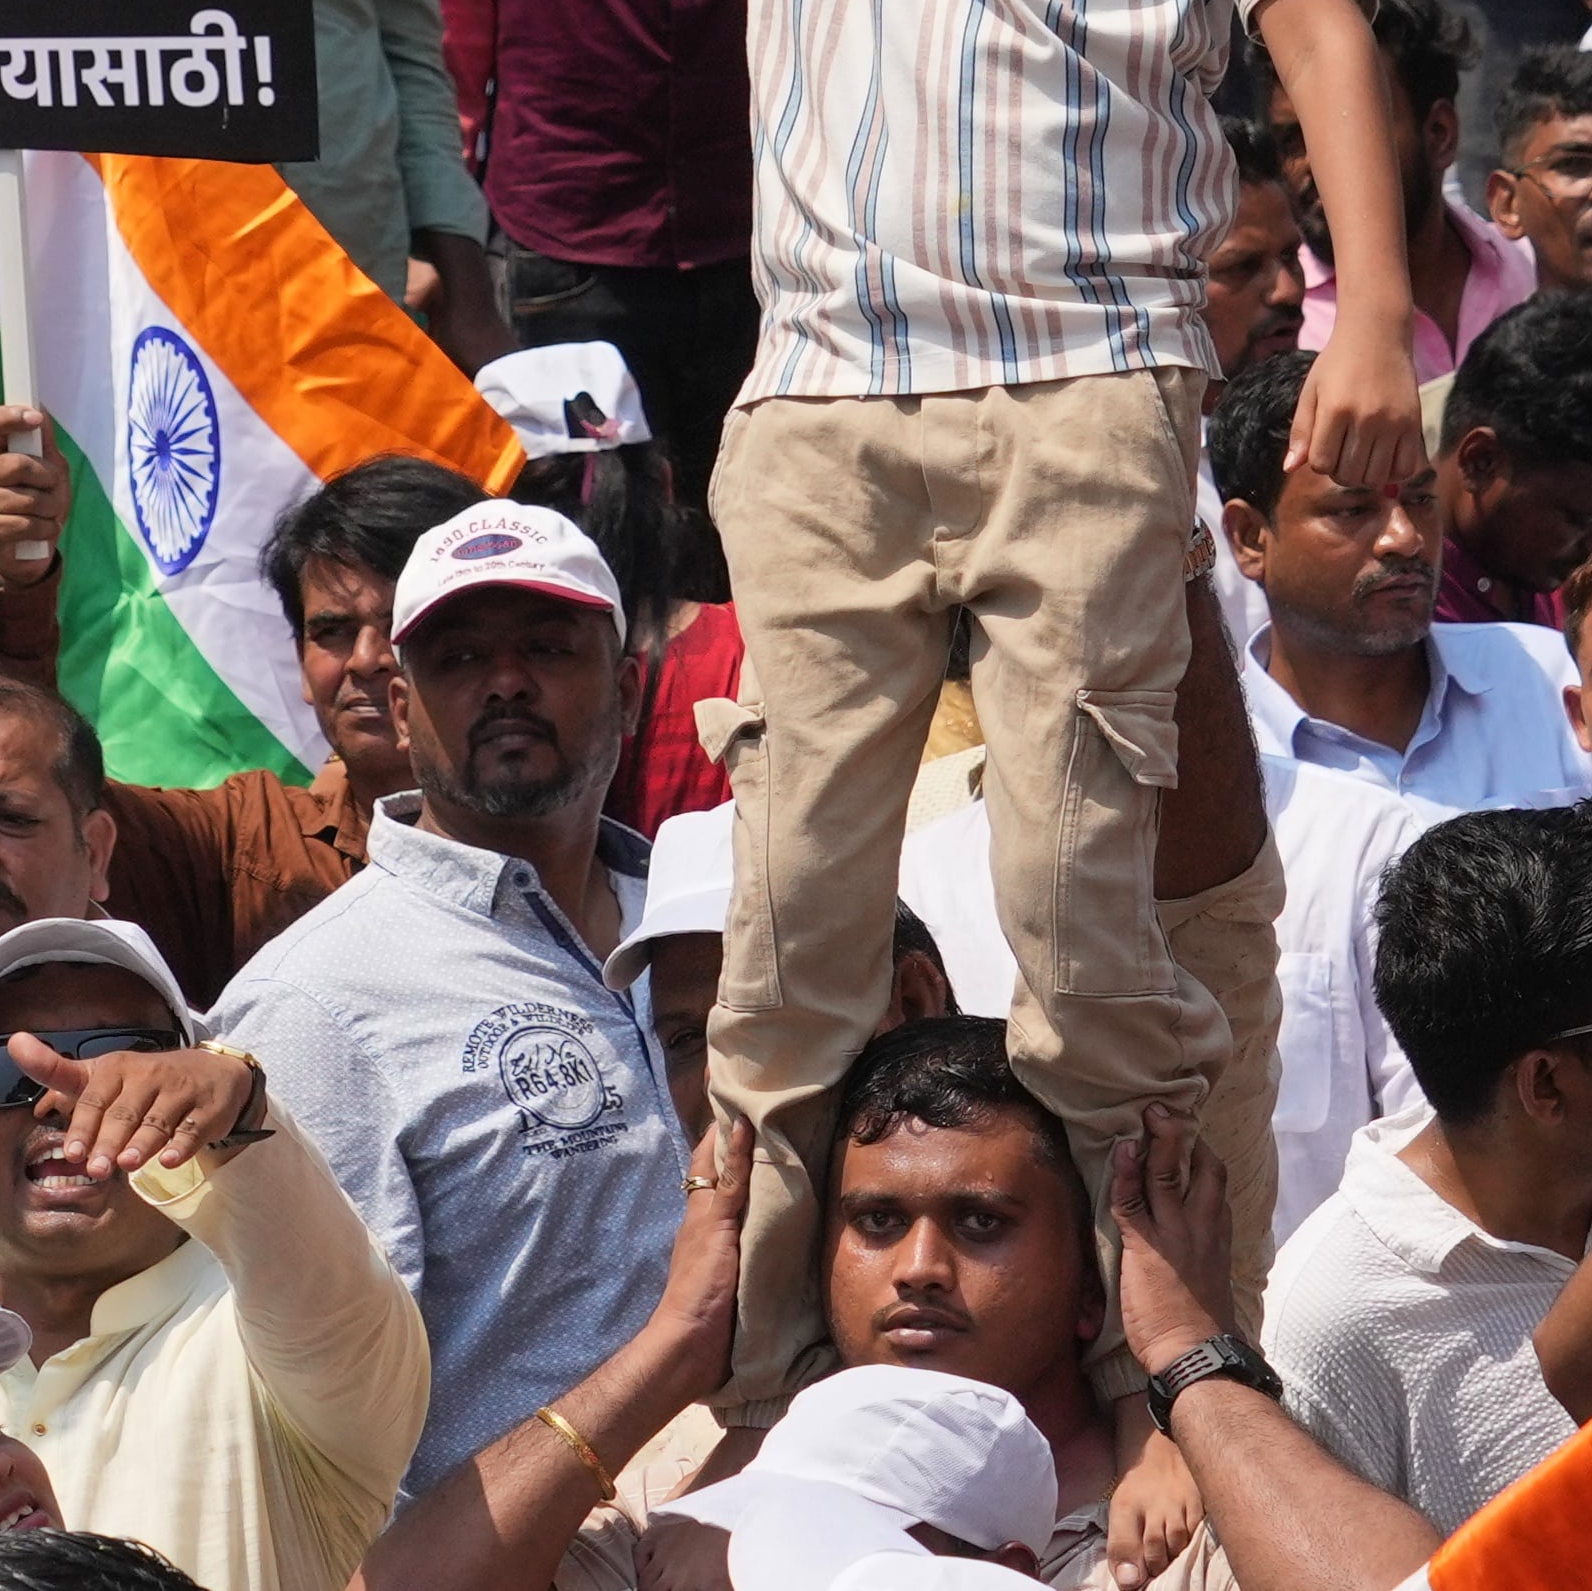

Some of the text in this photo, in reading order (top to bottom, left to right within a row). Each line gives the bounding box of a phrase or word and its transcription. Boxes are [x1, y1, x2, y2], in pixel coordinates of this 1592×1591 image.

[462, 1018, 495, 1073] REMOTE
[492, 1002, 596, 1035] WILDERNESS
[478, 1023, 511, 1069] OUTDOOR
[523, 1140, 559, 1156] THE
[550, 1135, 619, 1159] WANDERING
